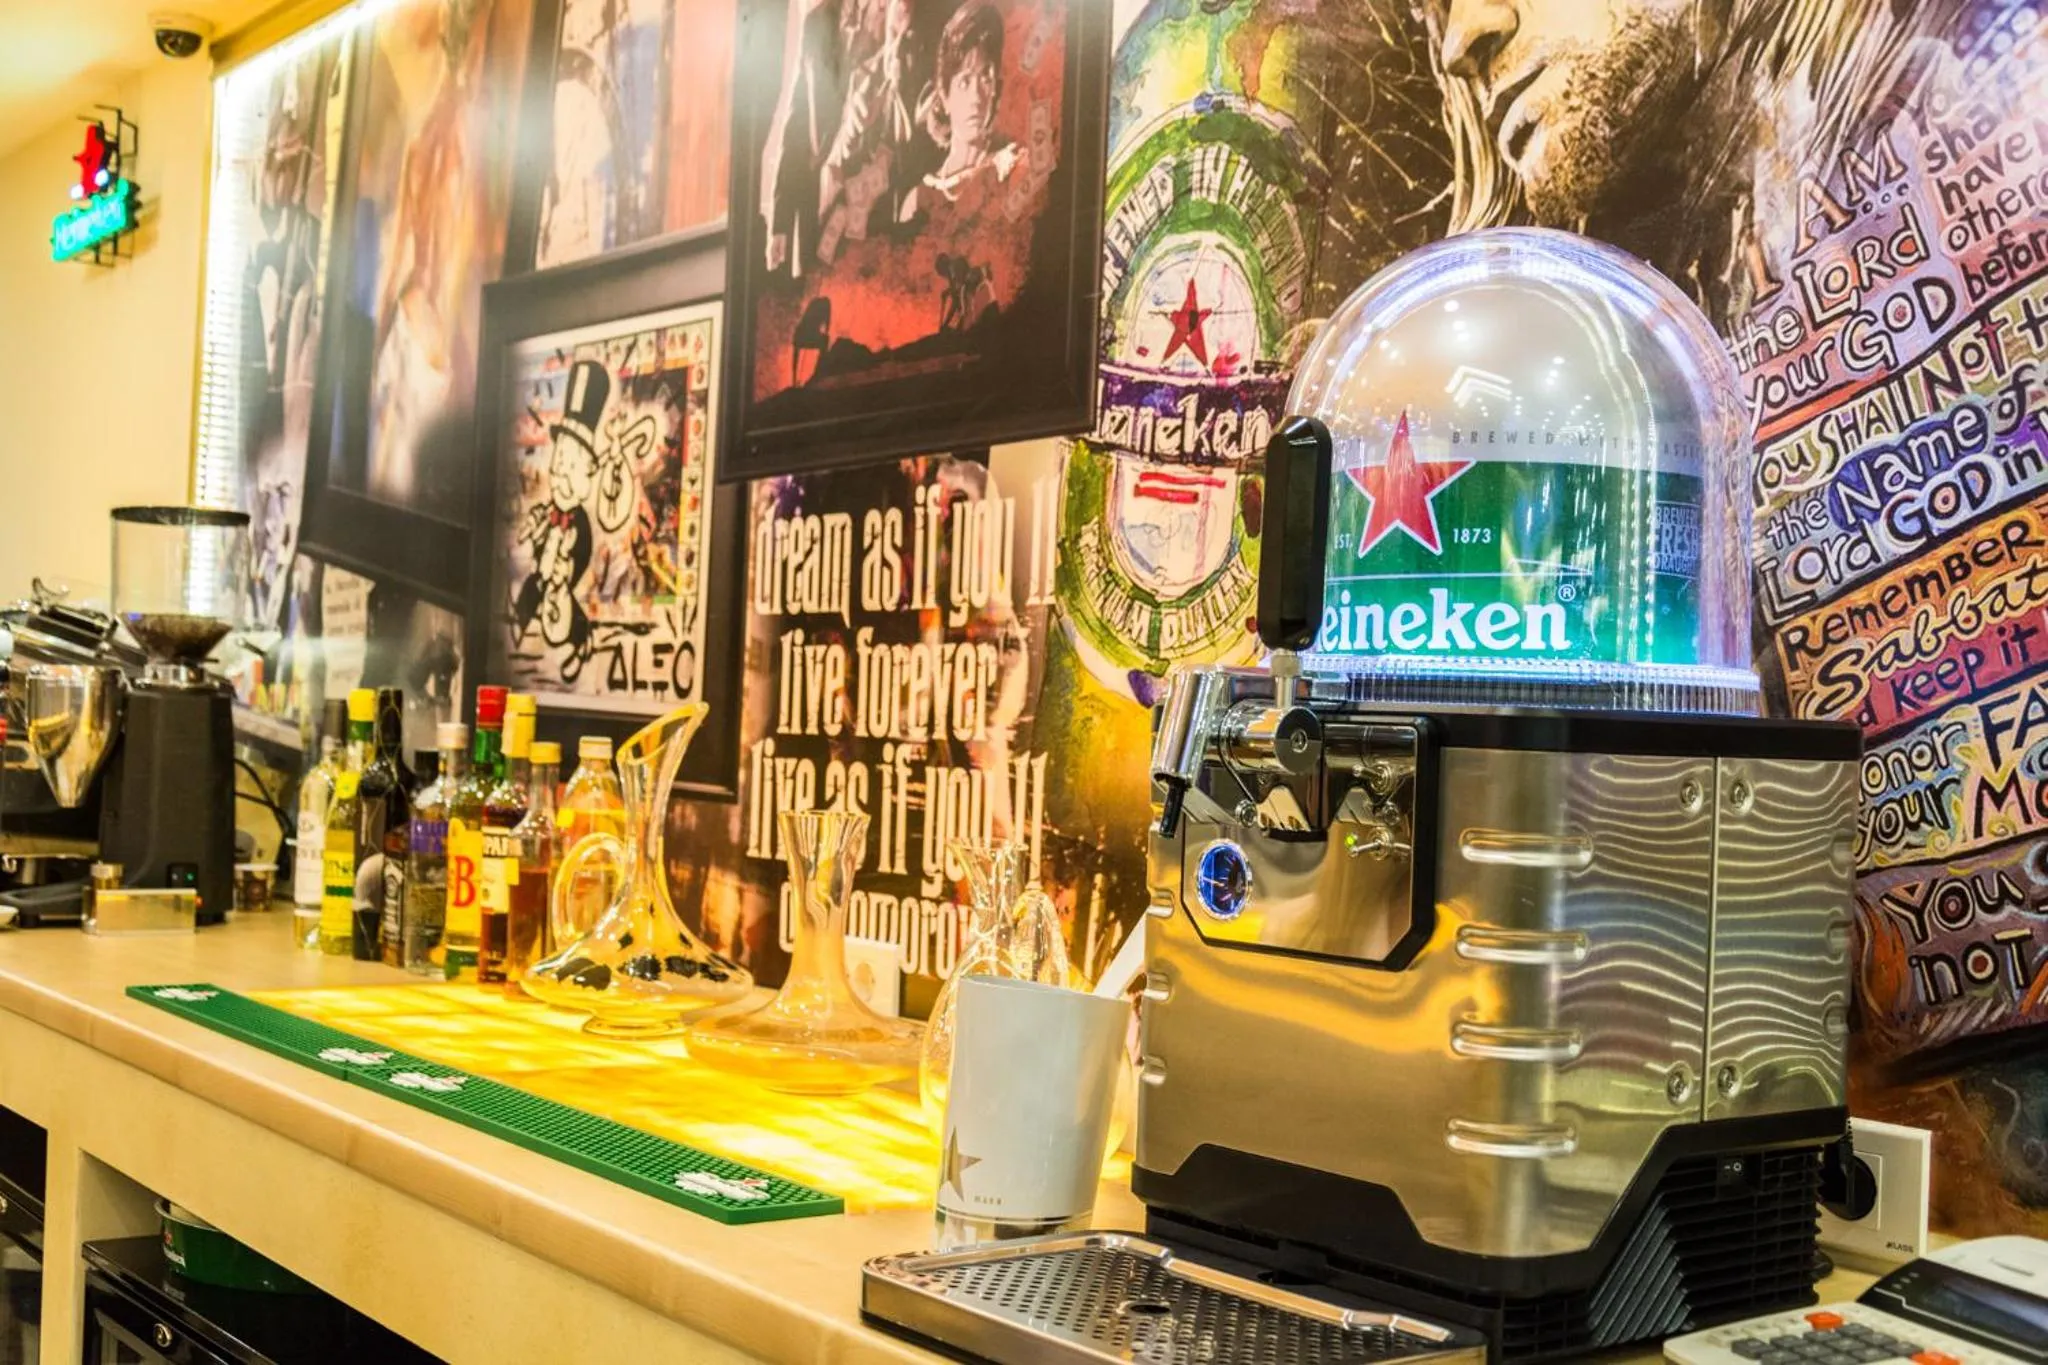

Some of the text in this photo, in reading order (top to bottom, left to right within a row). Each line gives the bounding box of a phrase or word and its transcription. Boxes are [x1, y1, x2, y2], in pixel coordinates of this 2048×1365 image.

[1936, 131, 2034, 216] have
[1948, 174, 2037, 253] other
[1960, 228, 2048, 302] befor
[1725, 306, 1807, 375] the
[1745, 337, 1836, 439] your
[1452, 429, 1556, 446] BREWED
[1765, 494, 1830, 552] the
[1835, 402, 1988, 525] Name
[1994, 362, 2038, 437] of
[754, 497, 853, 629] dream
[860, 506, 904, 612] as
[910, 483, 943, 611] if
[1452, 528, 1492, 545] 1873
[1759, 442, 2045, 621] Lord GOD in
[1318, 587, 1573, 651] eineken
[1996, 623, 2039, 667] it
[777, 626, 999, 742] live forever
[1858, 720, 1966, 804] onor
[876, 741, 914, 875] if
[1879, 870, 2026, 945] You
